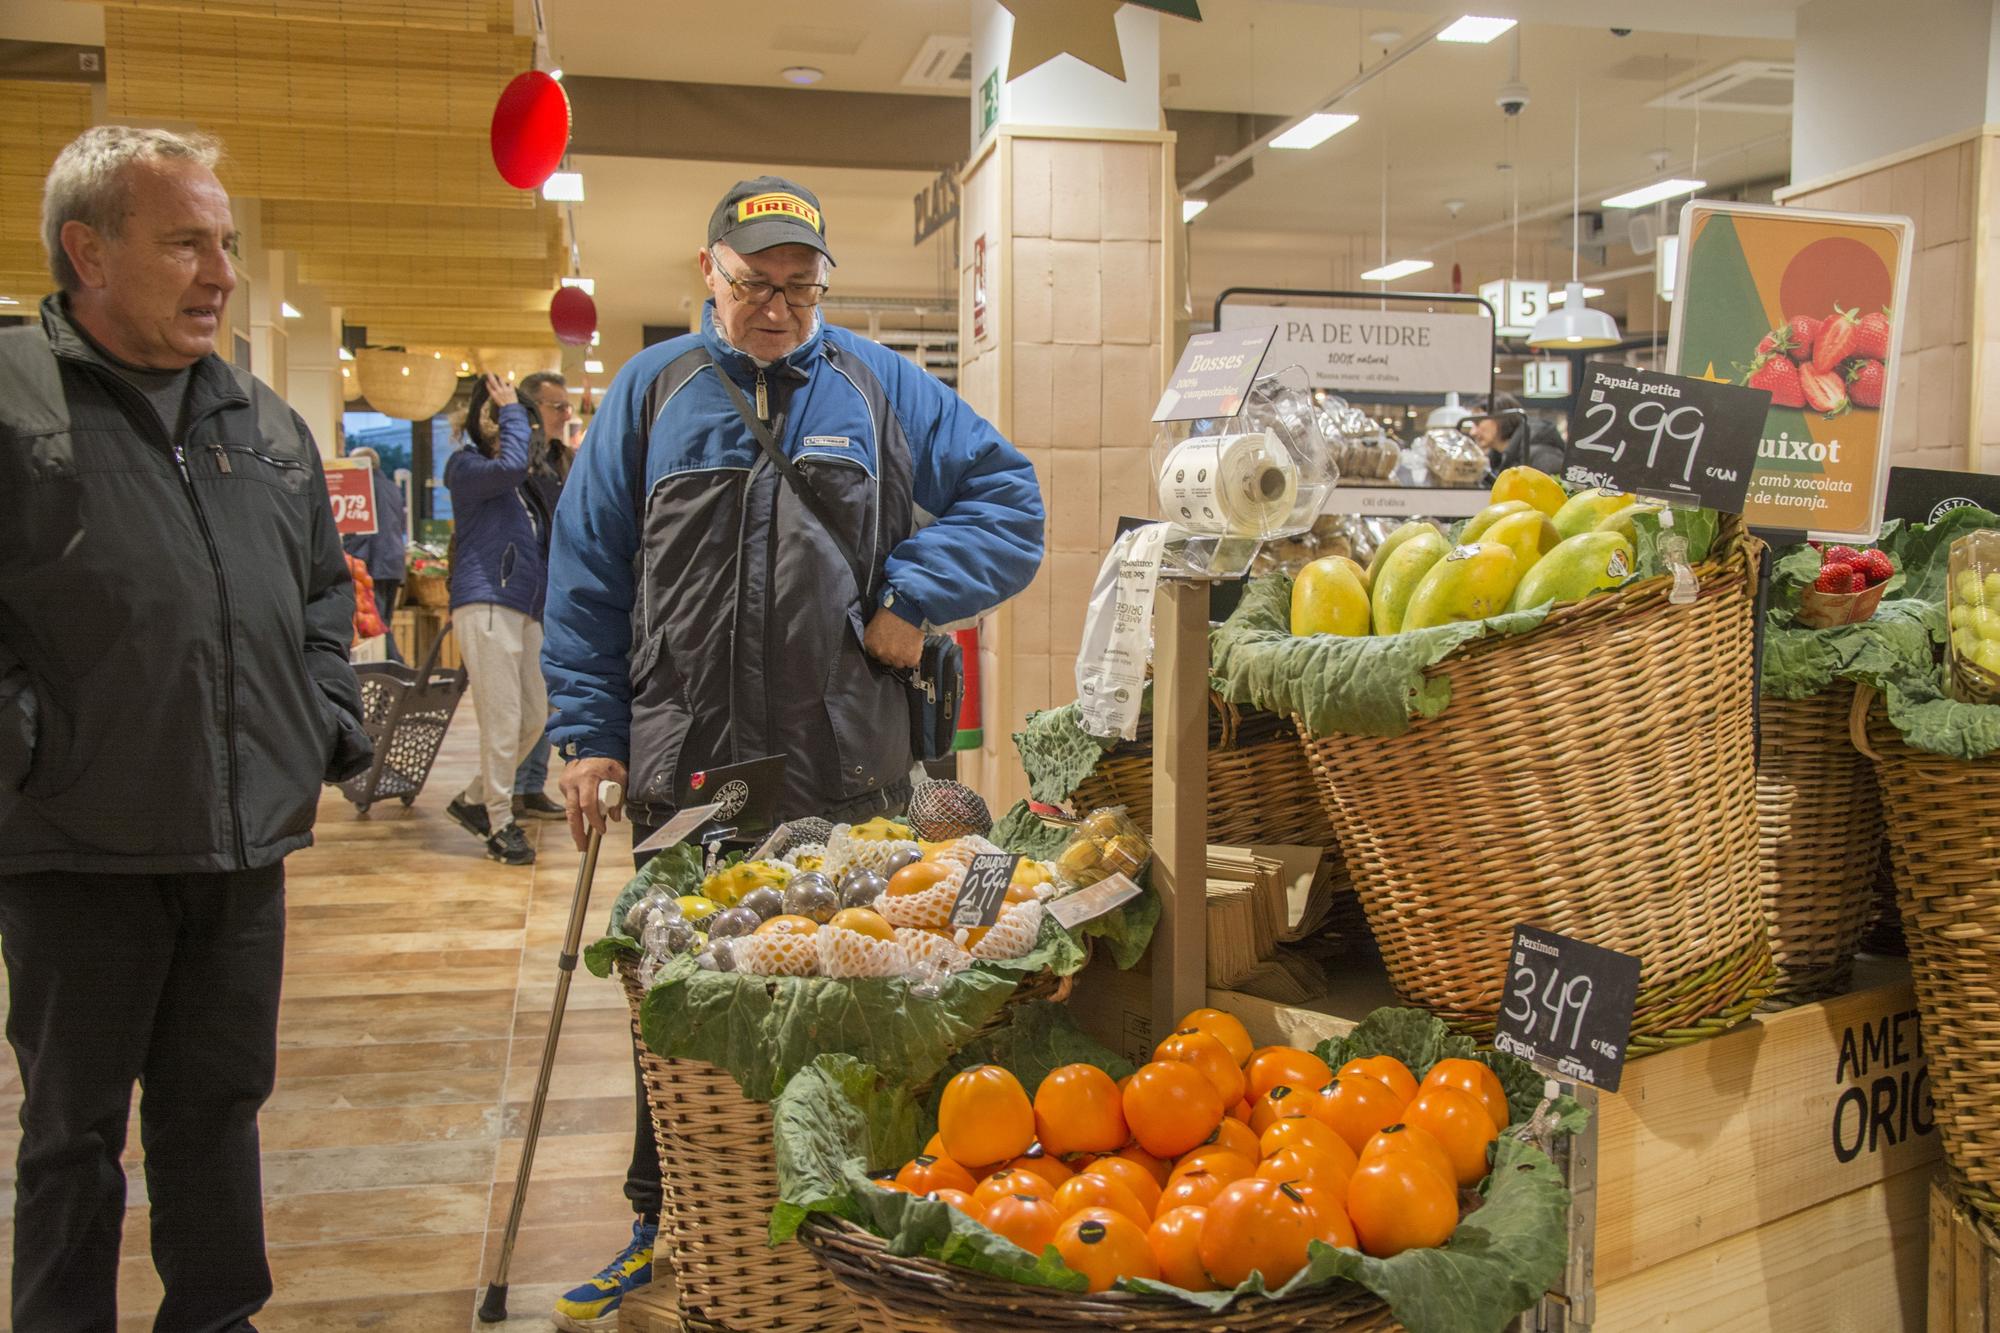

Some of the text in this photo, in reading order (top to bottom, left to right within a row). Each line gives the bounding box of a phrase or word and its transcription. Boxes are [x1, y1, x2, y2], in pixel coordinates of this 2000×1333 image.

[746, 199, 815, 224] PIRELLI
[1521, 290, 1536, 316] 5
[1287, 322, 1431, 347] PA DE VIDRE
[1188, 354, 1245, 373] Bosses
[1328, 352, 1389, 366] 100% natural
[1549, 369, 1557, 387] 1
[1595, 373, 1681, 398] Papaia petita
[1575, 401, 1704, 482] 2,99
[1760, 474, 1853, 492] amb xocolata
[1754, 491, 1772, 504] de
[1775, 492, 1828, 511] taronja.
[1519, 934, 1559, 957] Persimon
[1505, 968, 1593, 1050] 3,49
